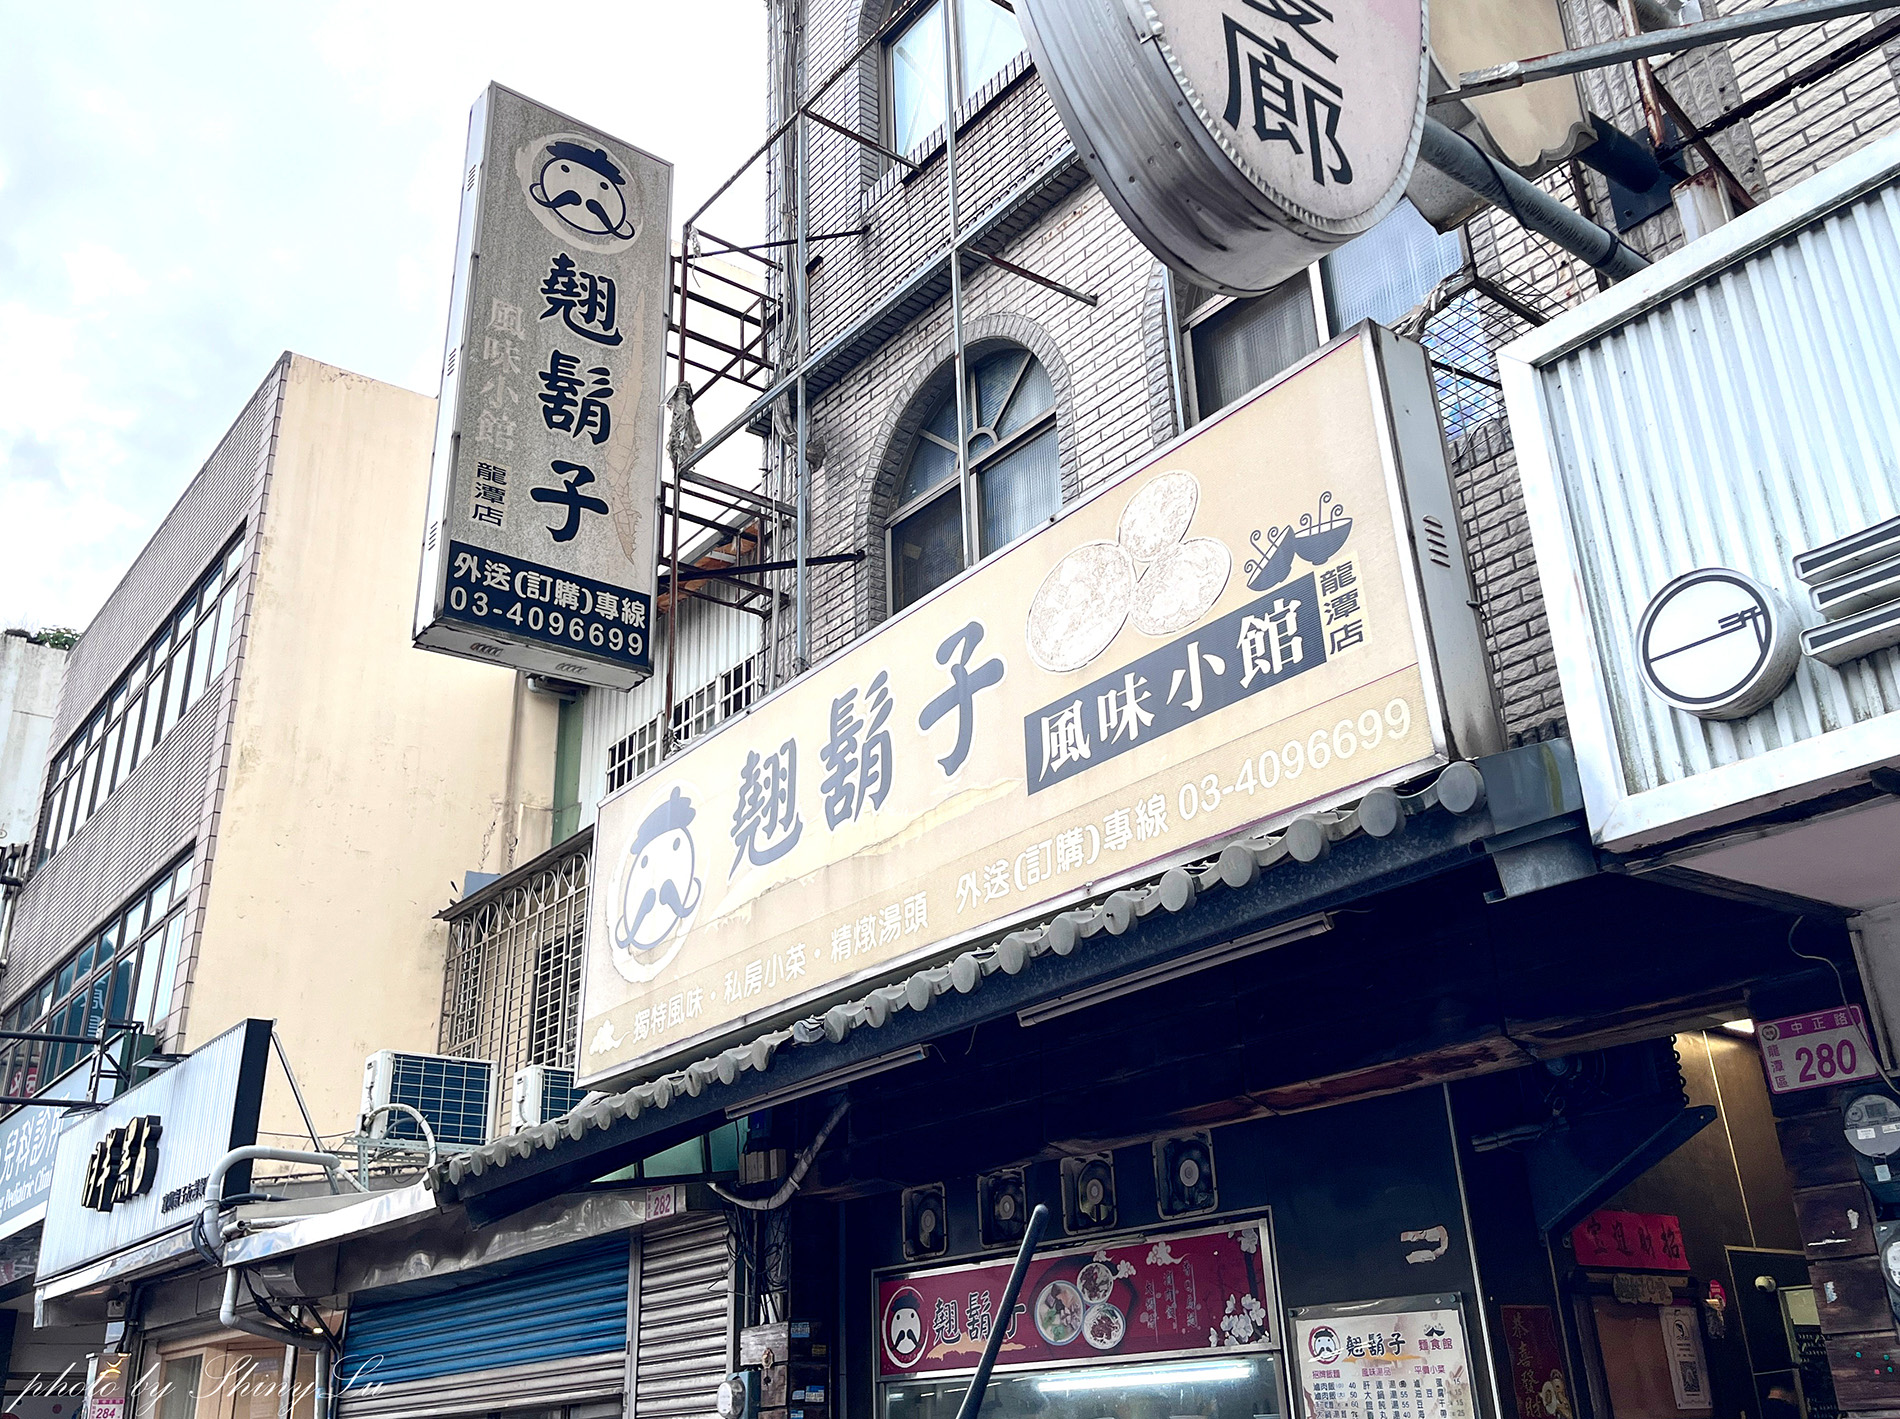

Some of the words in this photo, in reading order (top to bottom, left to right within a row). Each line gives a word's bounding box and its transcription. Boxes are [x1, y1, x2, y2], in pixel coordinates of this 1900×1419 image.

[530, 252, 624, 543] 翹鬍子
[472, 461, 507, 527] 龍潭店
[450, 586, 643, 656] 03-4096699
[1319, 559, 1364, 656] 龍潭店
[1039, 598, 1302, 782] 風味小館
[728, 621, 1004, 881] 翹鬍子
[1179, 698, 1412, 821] 03-4096699
[1790, 1012, 1848, 1034] 中正路
[1766, 1044, 1789, 1088] 龍潭區
[1795, 1039, 1857, 1083] 280
[653, 1194, 671, 1216] 282
[96, 1407, 116, 1418] 284
